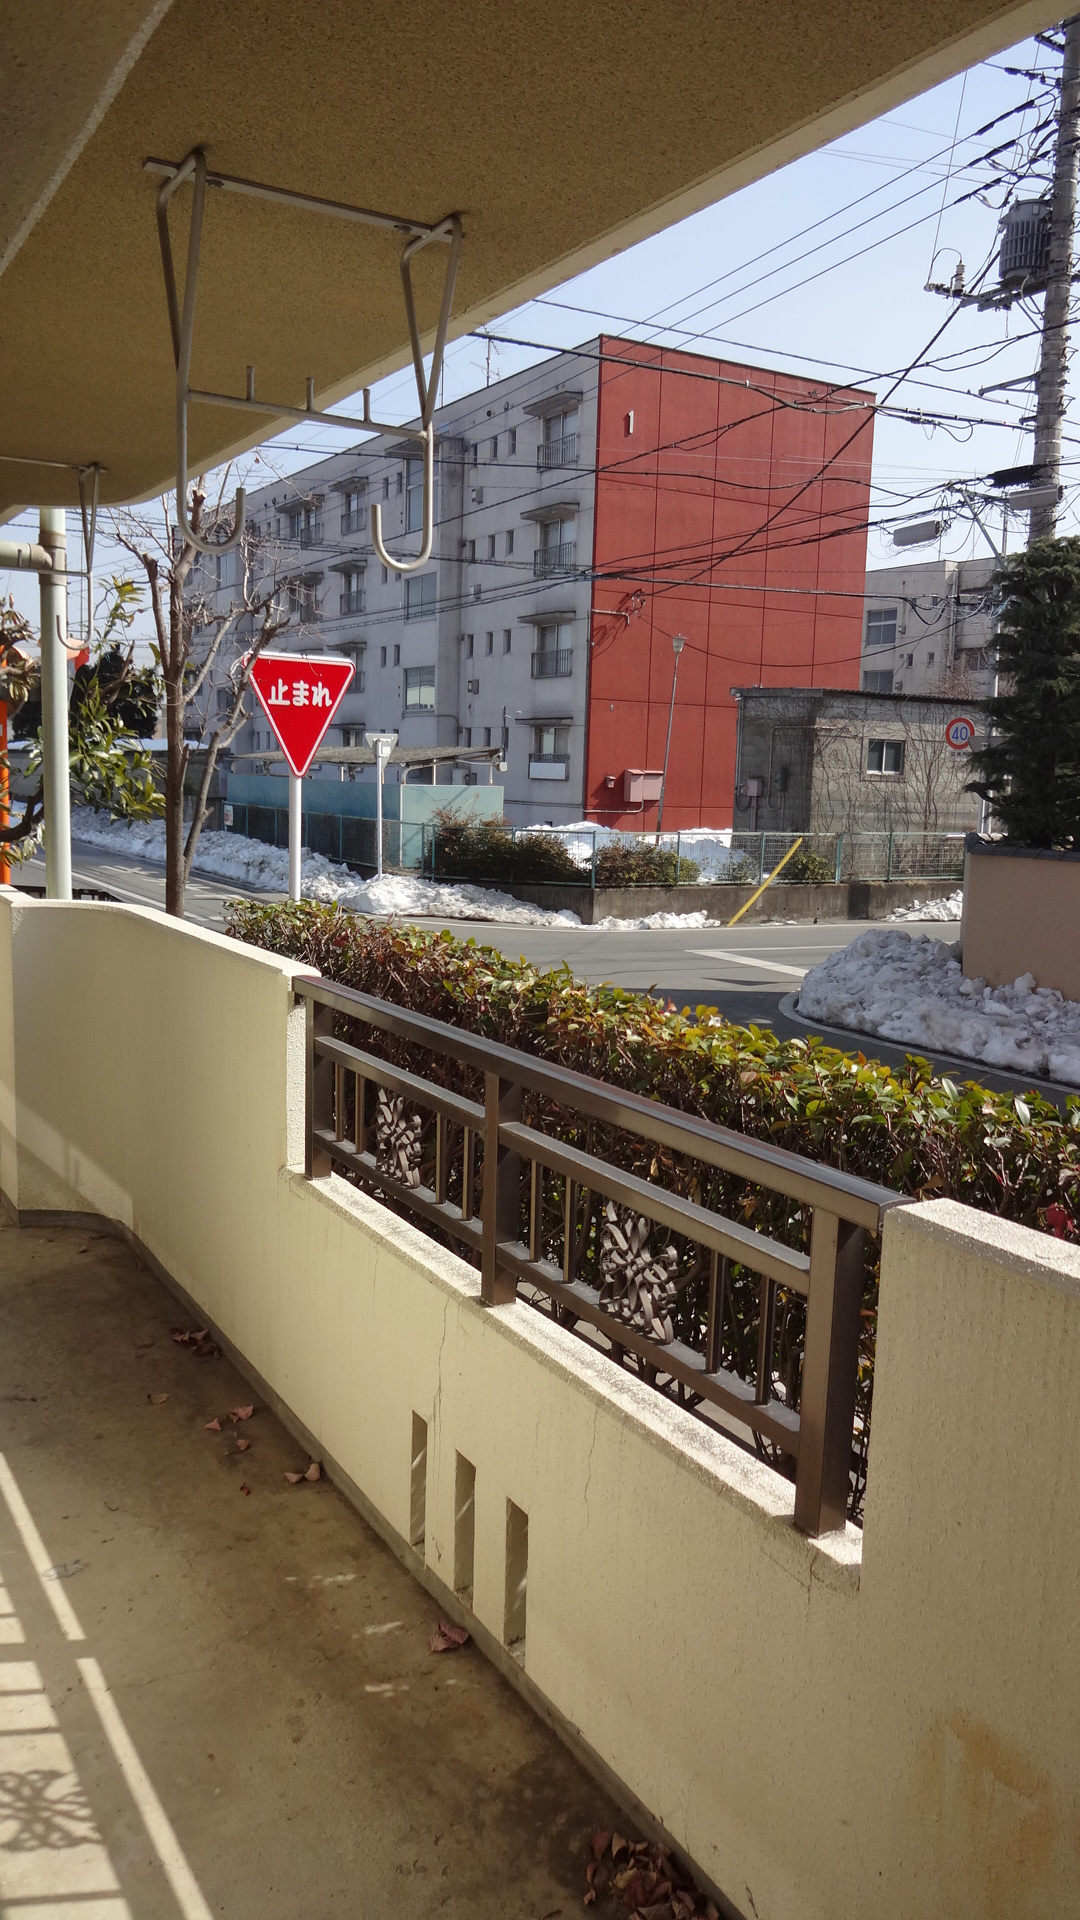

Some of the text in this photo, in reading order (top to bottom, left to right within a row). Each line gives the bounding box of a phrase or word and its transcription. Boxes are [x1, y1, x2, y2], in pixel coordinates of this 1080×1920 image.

[628, 410, 634, 433] 1
[267, 678, 333, 708] 止まれ
[952, 726, 968, 741] 40
